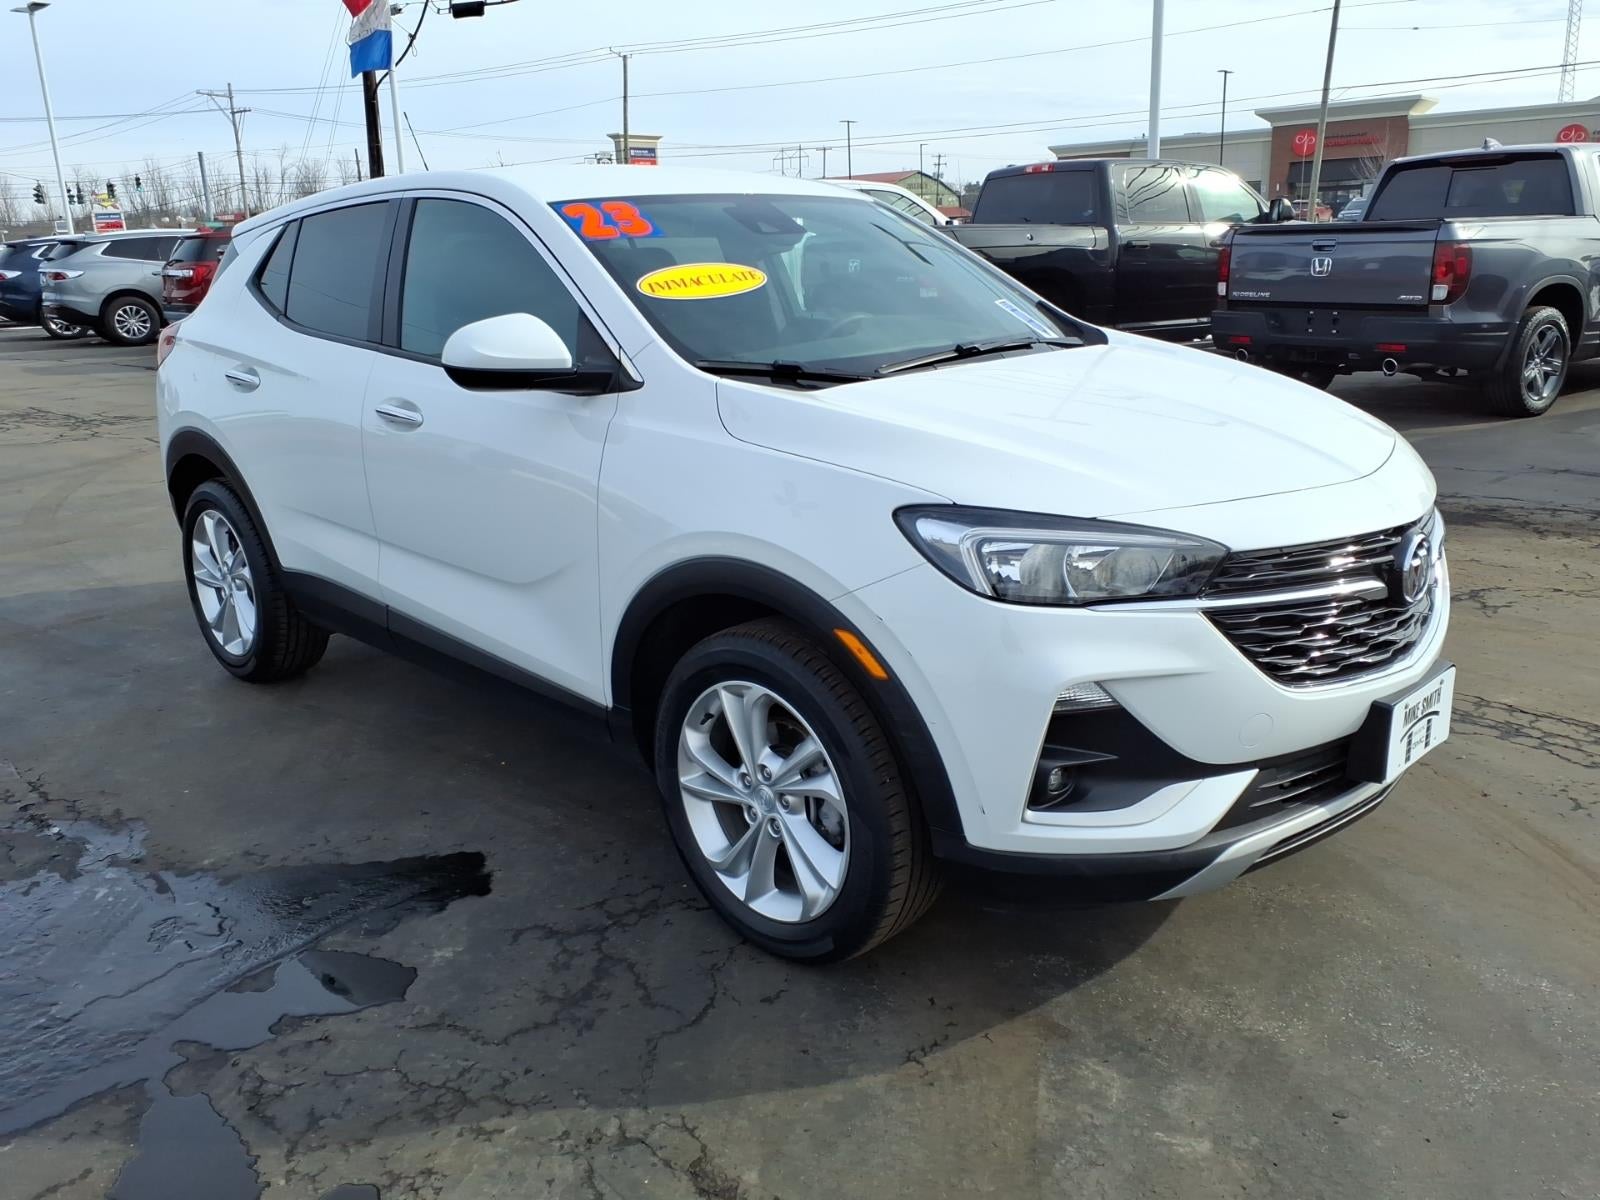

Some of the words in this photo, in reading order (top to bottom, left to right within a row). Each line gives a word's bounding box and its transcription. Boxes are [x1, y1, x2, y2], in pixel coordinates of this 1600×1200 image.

[562, 201, 653, 240] 23
[647, 269, 762, 293] IMMACULATE
[1403, 700, 1421, 729] MIKE
[1421, 686, 1442, 715] SMITH
